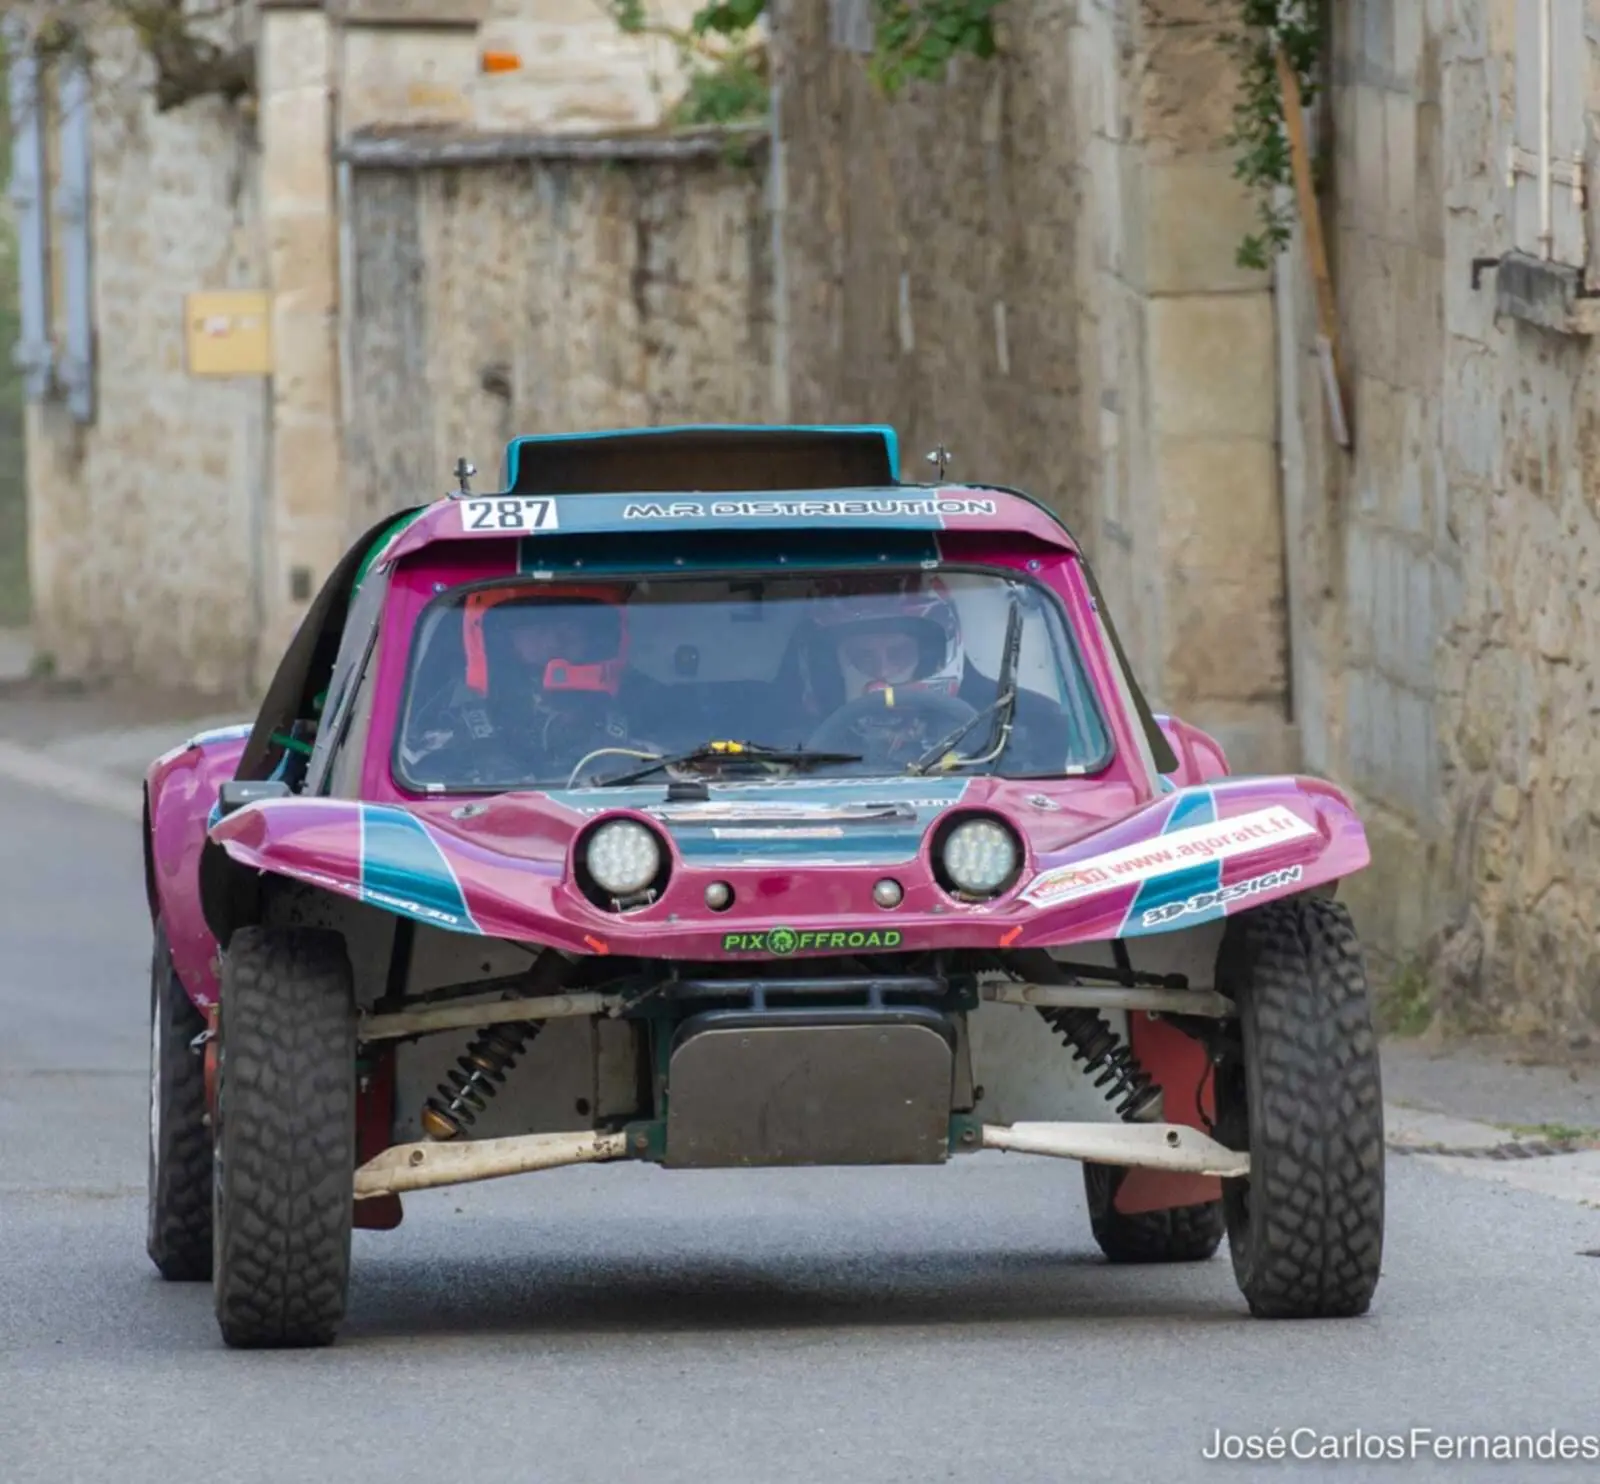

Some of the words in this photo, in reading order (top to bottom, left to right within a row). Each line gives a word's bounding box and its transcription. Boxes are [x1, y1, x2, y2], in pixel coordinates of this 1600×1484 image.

[468, 500, 551, 529] 287
[623, 502, 706, 519] M.R
[711, 499, 997, 517] DISTRIBUTION
[1108, 815, 1296, 876] www.agoratt.fr
